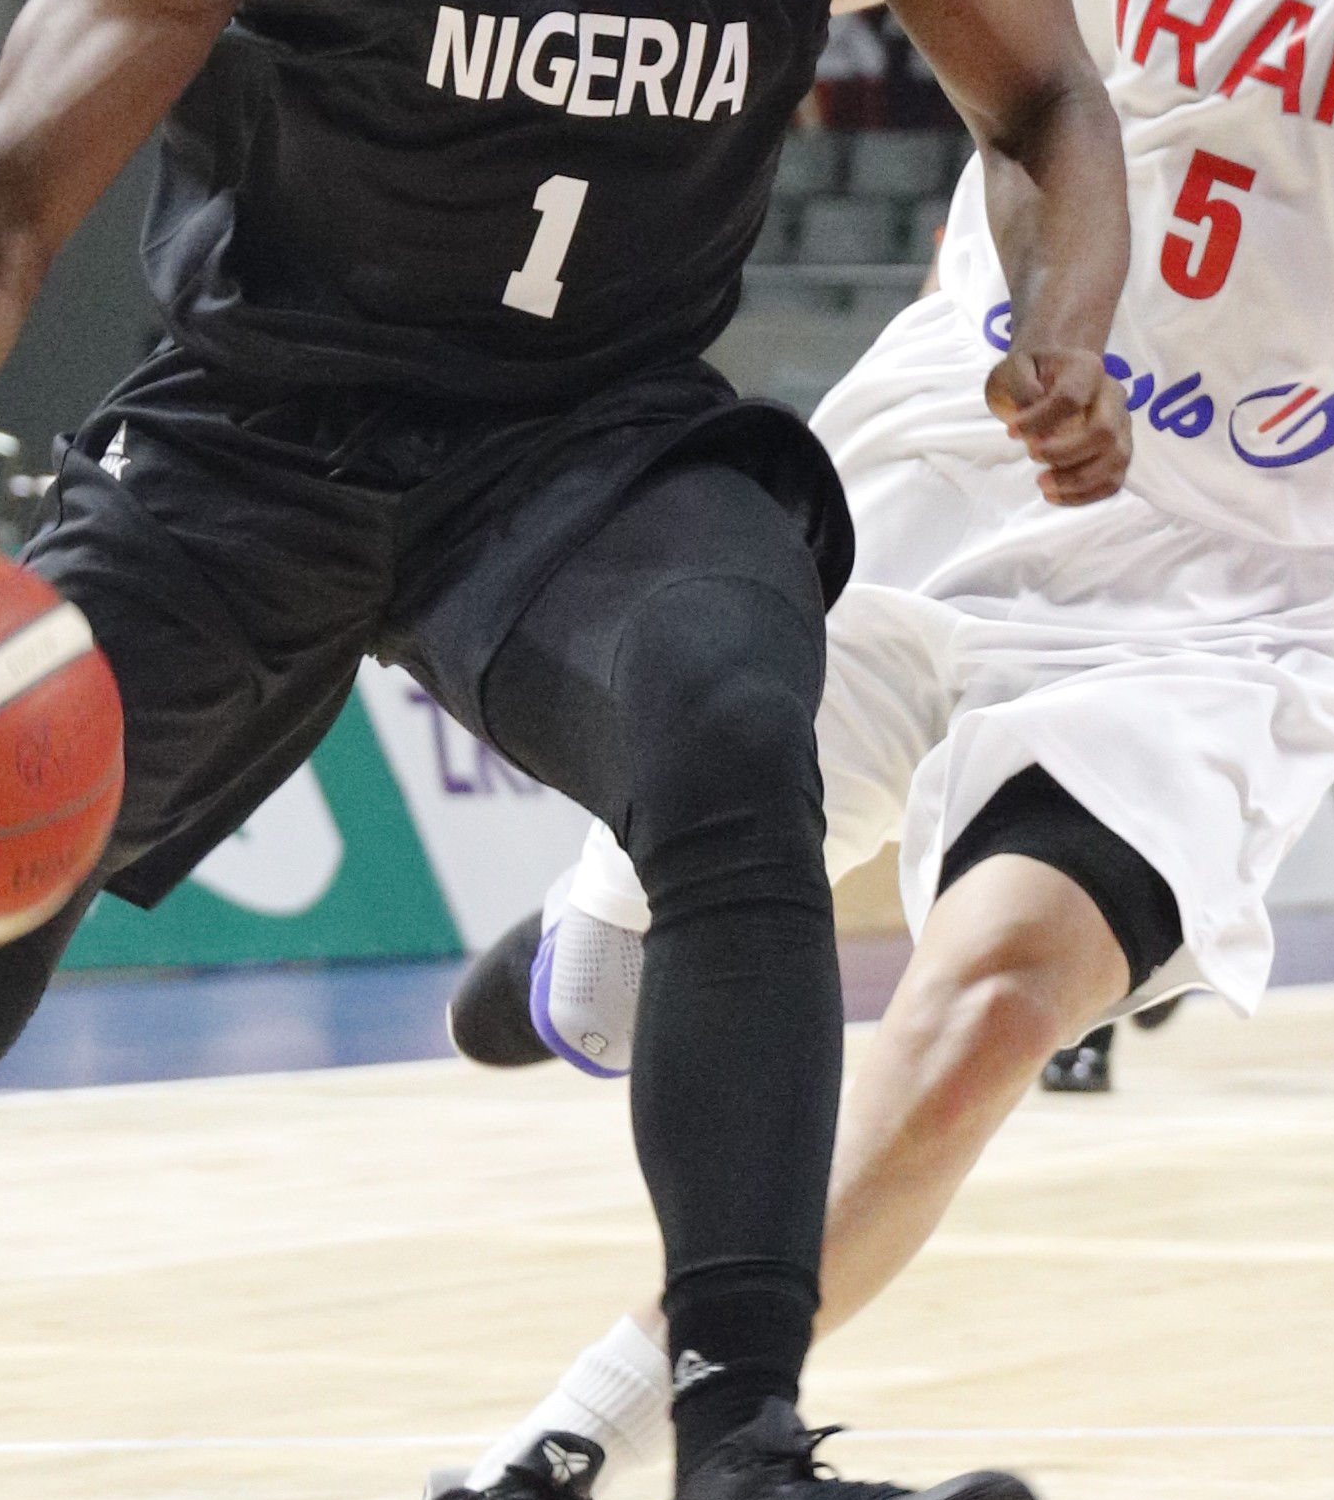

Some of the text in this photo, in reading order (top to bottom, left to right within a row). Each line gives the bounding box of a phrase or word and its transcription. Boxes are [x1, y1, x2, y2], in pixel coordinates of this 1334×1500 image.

[426, 5, 749, 121] NIGERIA
[501, 174, 589, 319] 1
[1160, 149, 1255, 300] 5
